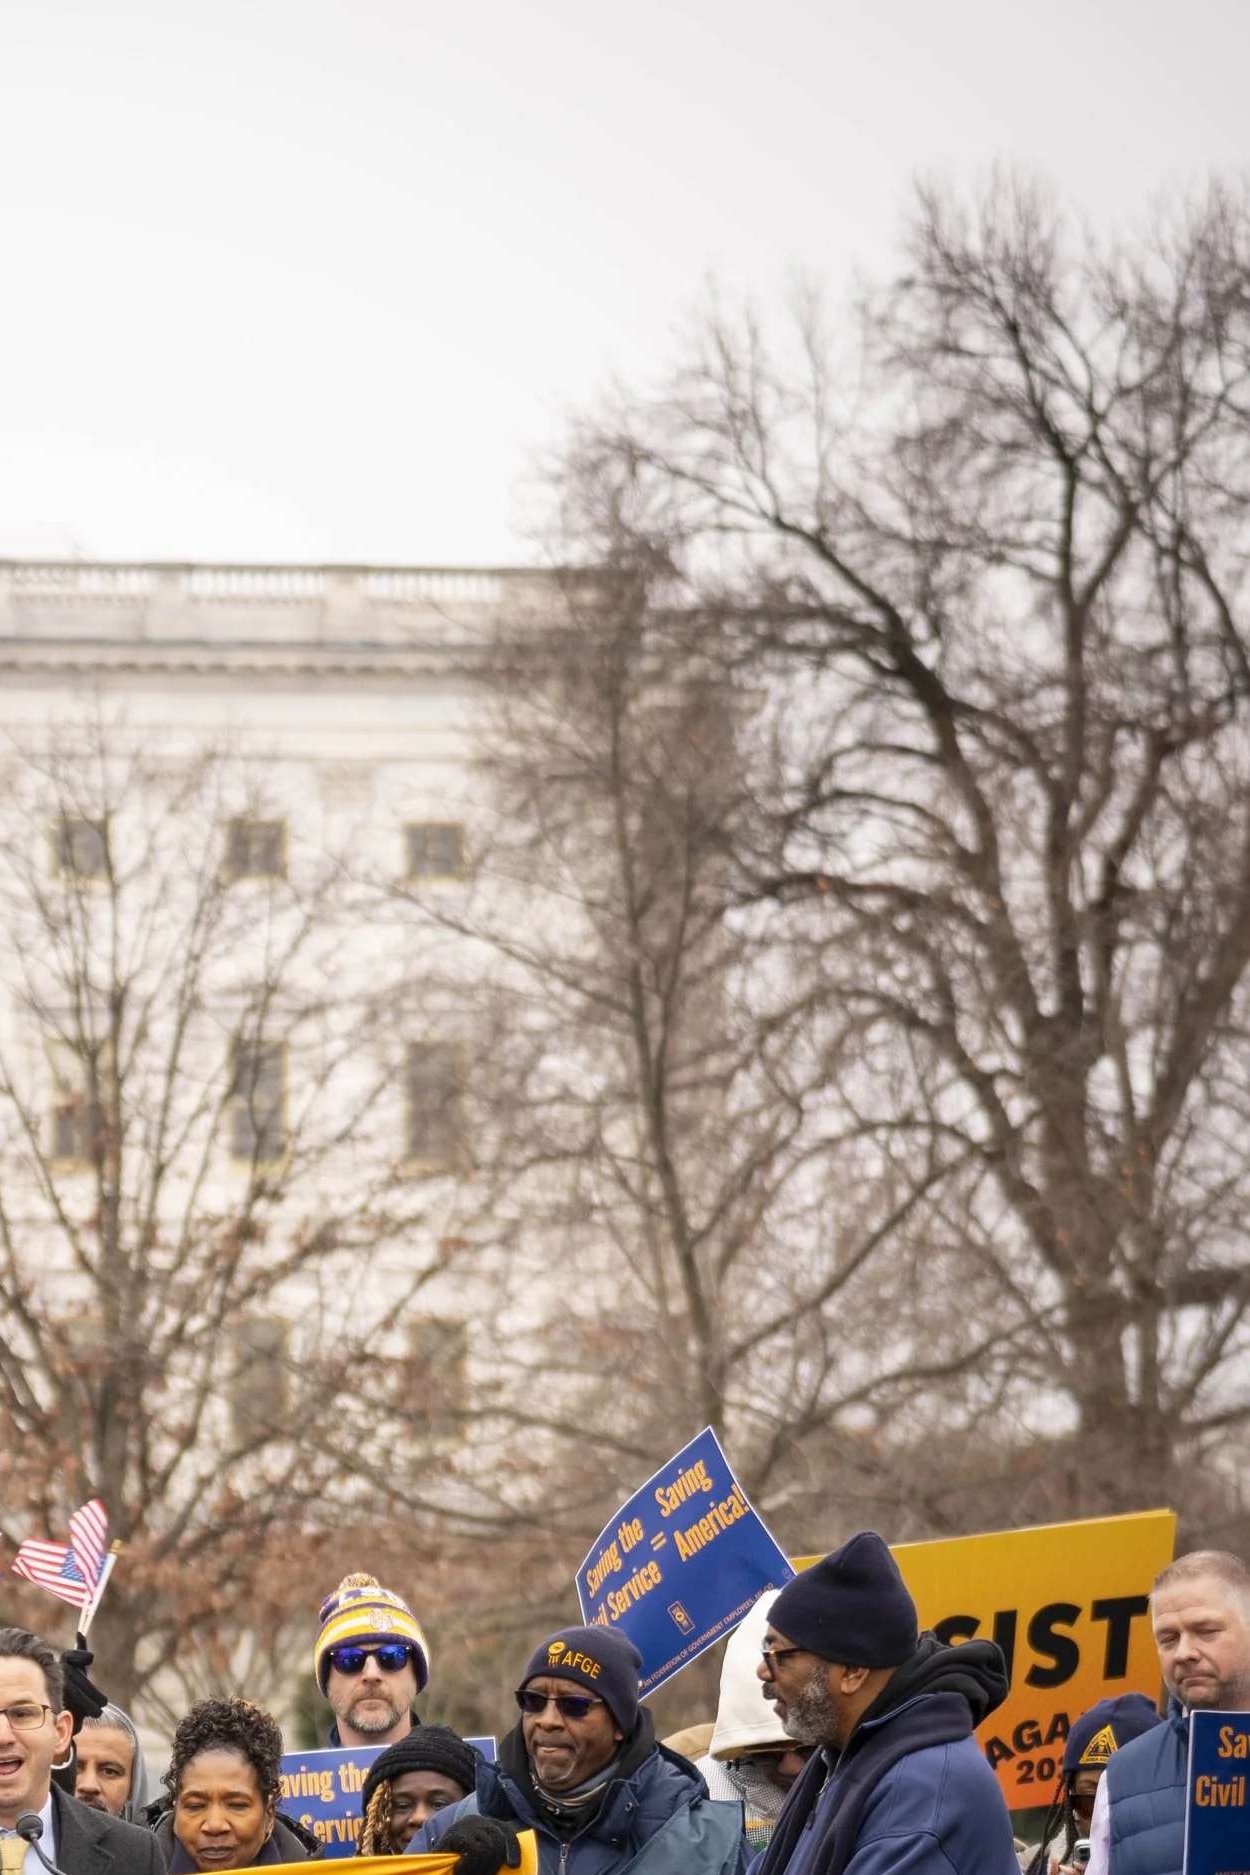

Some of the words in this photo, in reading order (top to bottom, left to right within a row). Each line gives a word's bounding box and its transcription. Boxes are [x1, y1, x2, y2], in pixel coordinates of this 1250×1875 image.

[654, 1459, 713, 1518] Saving
[672, 1483, 750, 1563] America!
[586, 1540, 623, 1598] Saving
[617, 1518, 645, 1554] the
[607, 1560, 663, 1622] Service
[561, 1650, 601, 1679] AFGE
[650, 1655, 682, 1682] FEDERATION
[687, 1621, 724, 1653] GOVERNMENT
[984, 1711, 1071, 1770] AGA
[1218, 1725, 1250, 1759] Sa
[278, 1766, 335, 1803] aving
[1195, 1775, 1246, 1807] Civil
[299, 1811, 365, 1843] Servic
